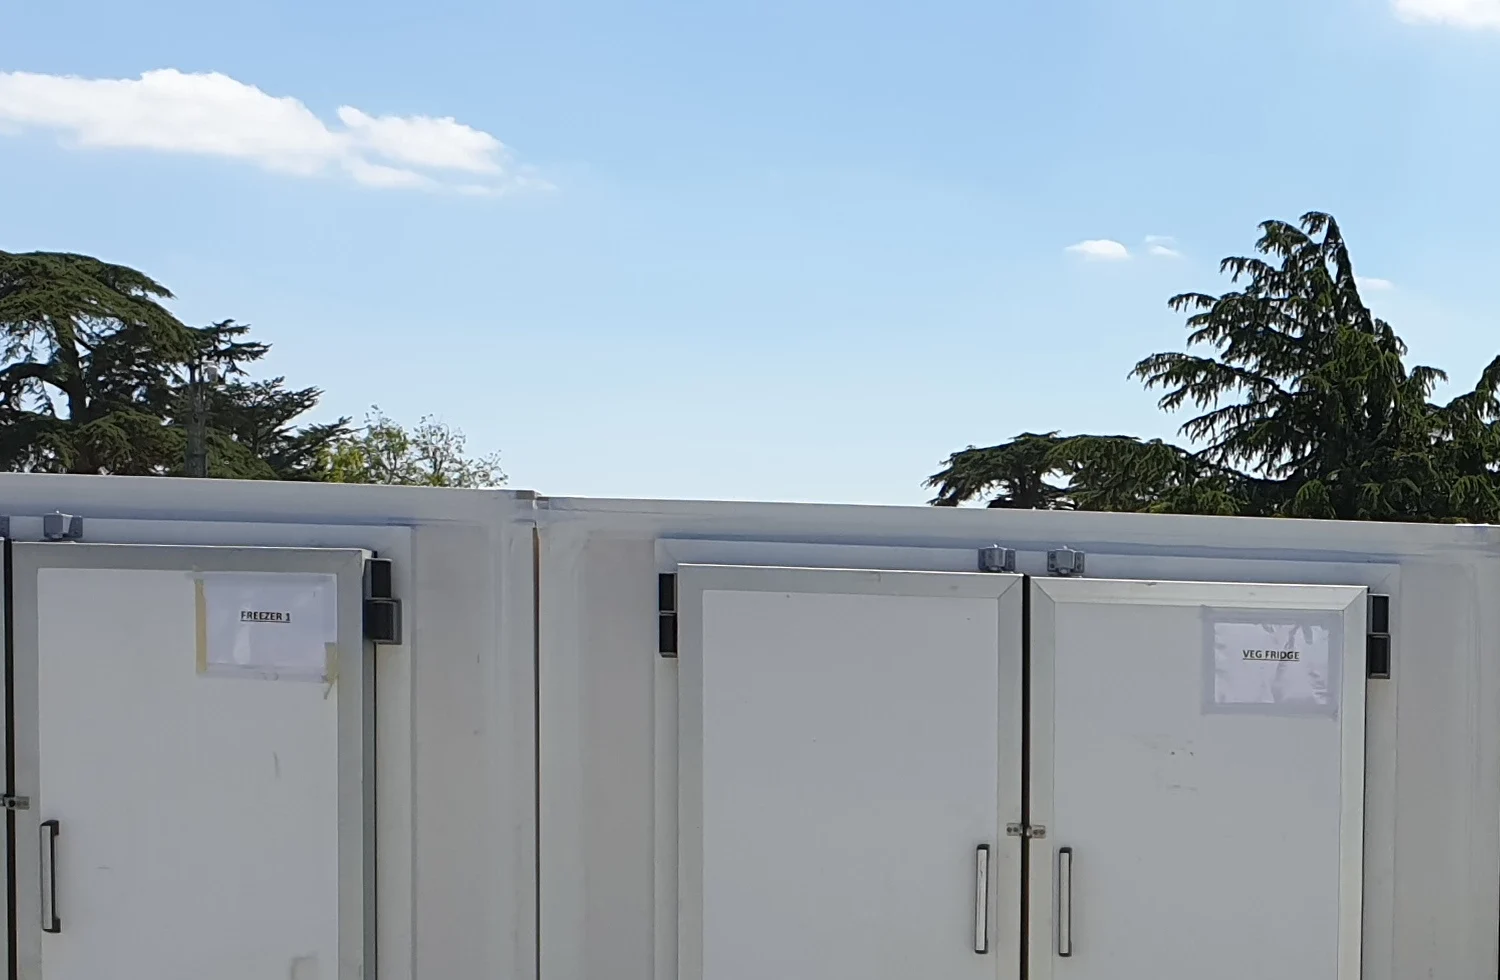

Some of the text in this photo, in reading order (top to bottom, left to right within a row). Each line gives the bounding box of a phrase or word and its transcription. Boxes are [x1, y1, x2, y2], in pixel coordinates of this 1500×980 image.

[240, 610, 282, 621] FREEZER
[1242, 649, 1300, 661] VEG FRIDGE
